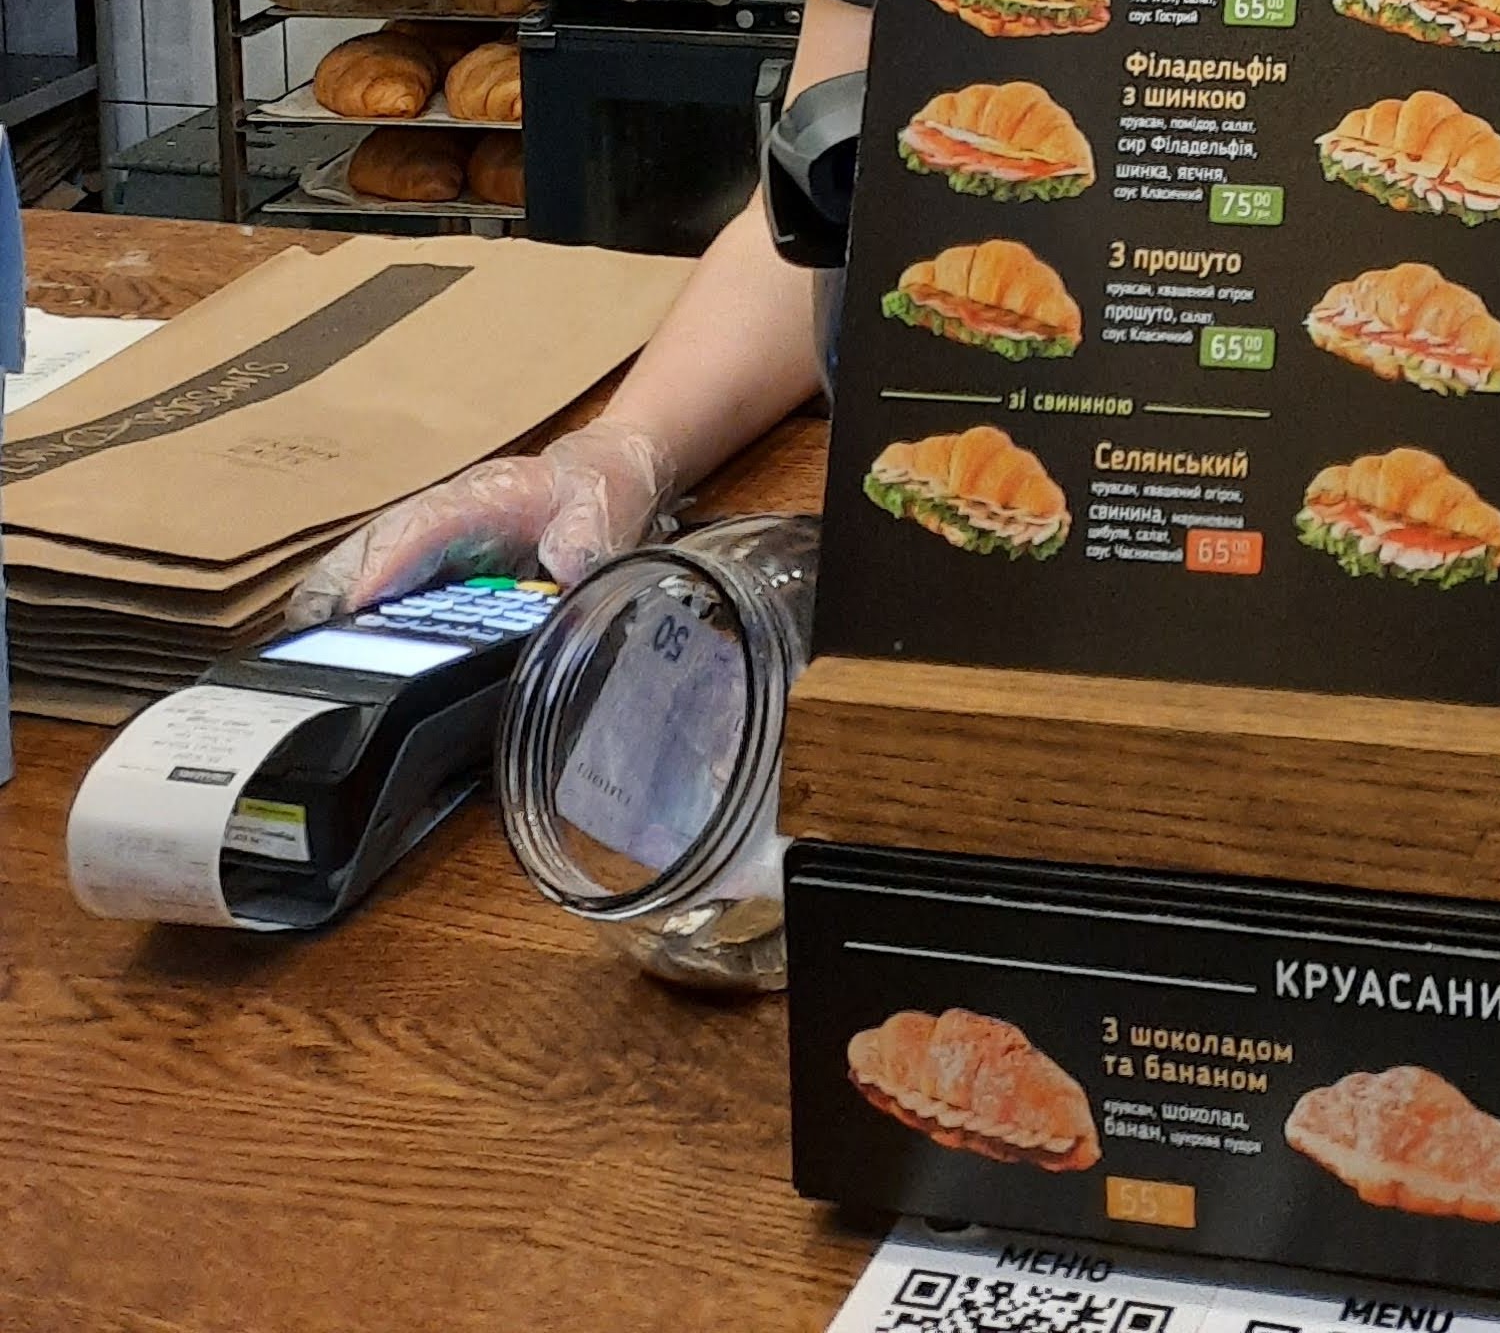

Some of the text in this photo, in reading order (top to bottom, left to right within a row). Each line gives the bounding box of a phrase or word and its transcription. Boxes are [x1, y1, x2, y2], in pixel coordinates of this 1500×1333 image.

[1125, 52, 1288, 86] Філадельфія
[1144, 87, 1247, 109] шинкою
[1134, 247, 1242, 277] прошуто
[1008, 389, 1134, 416] зі свининою
[1094, 442, 1249, 479] Селянський
[1130, 1026, 1294, 1064] шоколадом
[1103, 1052, 1268, 1094] та бананом
[997, 1246, 1113, 1282] МЕНЮ
[1342, 1297, 1454, 1333] MENU
